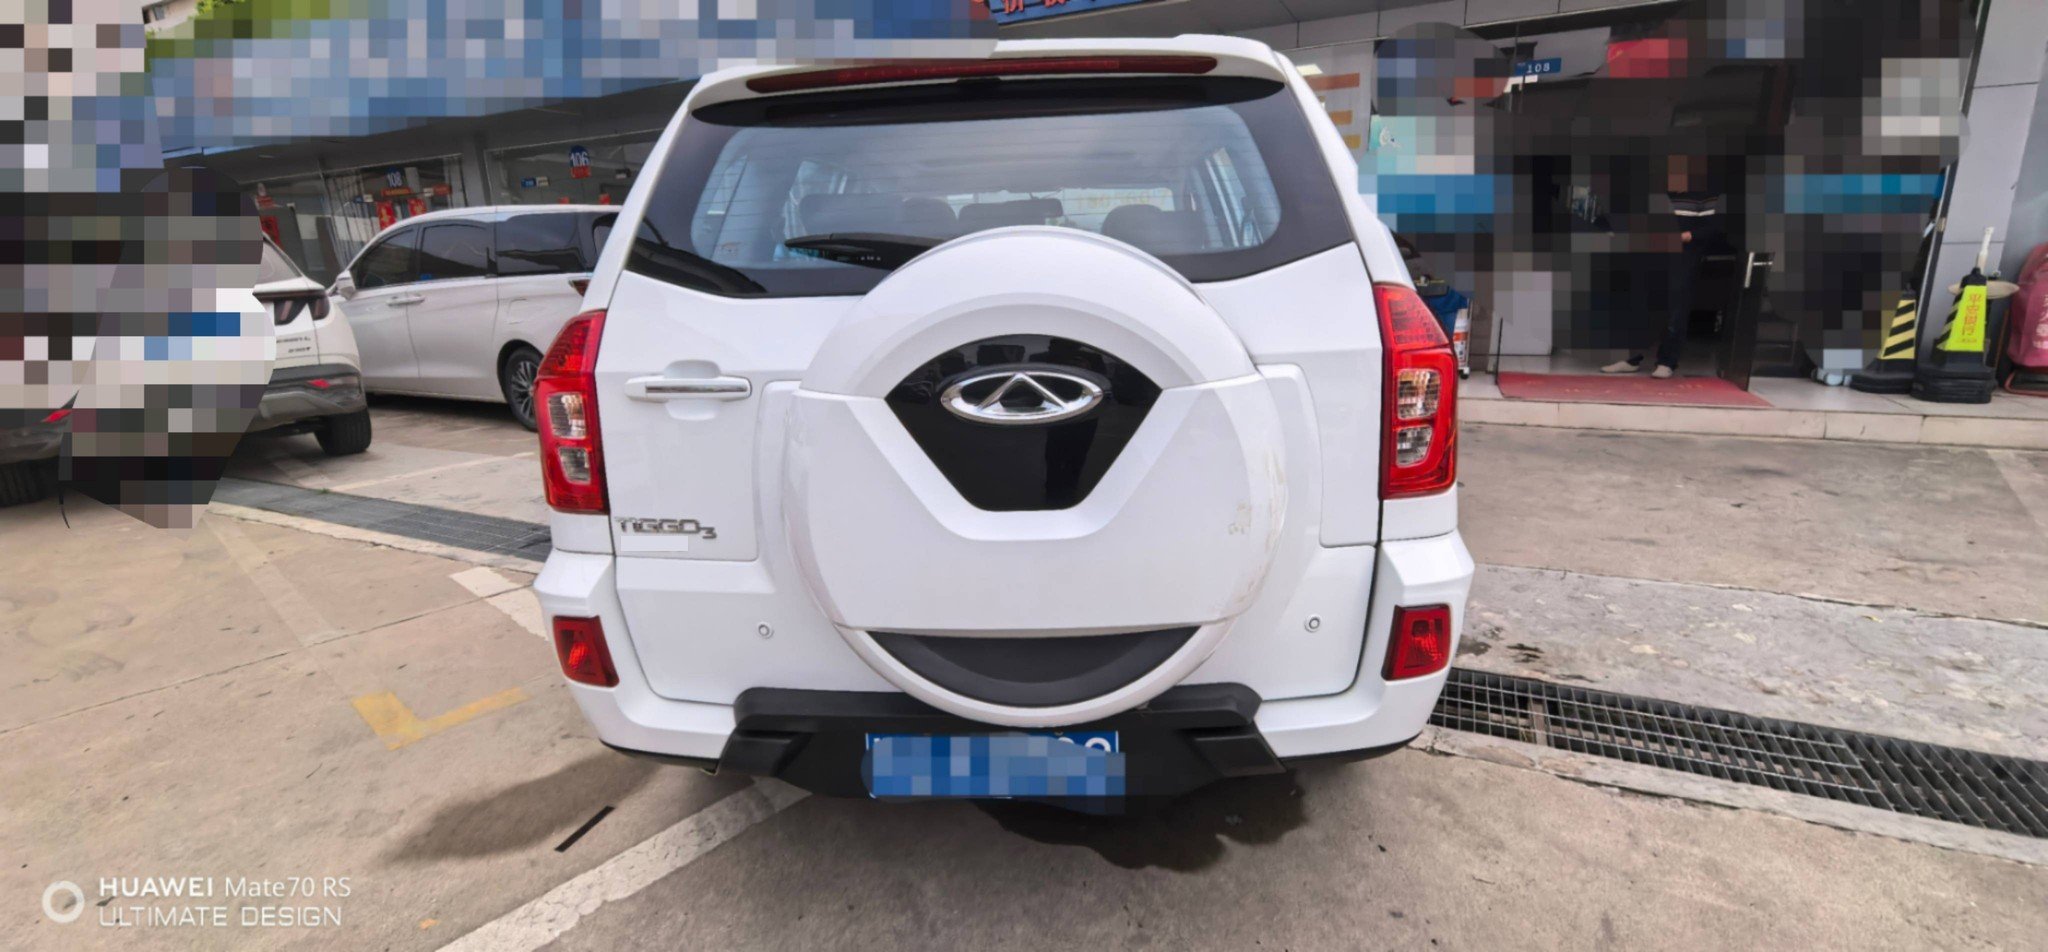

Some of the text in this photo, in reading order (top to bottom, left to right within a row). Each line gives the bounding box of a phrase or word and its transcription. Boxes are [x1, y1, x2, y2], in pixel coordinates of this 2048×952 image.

[1527, 63, 1550, 73] 108
[570, 152, 589, 167] 106
[387, 171, 403, 187] 108
